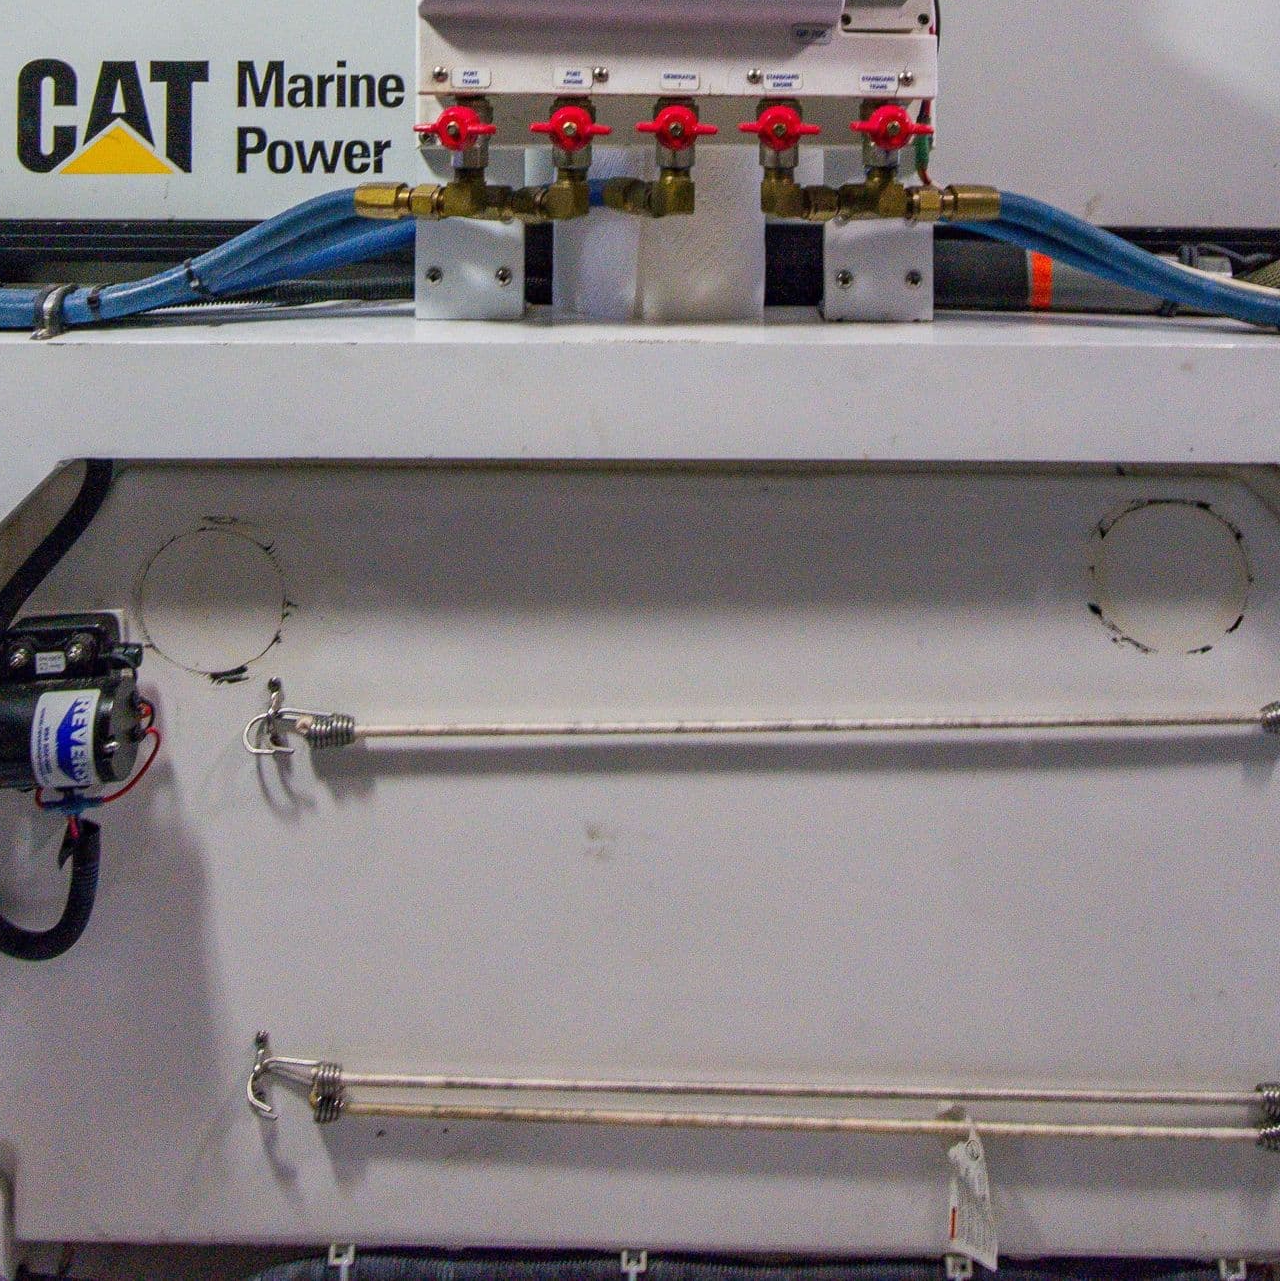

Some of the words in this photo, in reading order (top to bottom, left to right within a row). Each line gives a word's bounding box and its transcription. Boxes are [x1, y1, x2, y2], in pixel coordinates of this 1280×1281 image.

[237, 59, 406, 109] Marine
[17, 57, 210, 174] CAT
[237, 126, 392, 175] Power
